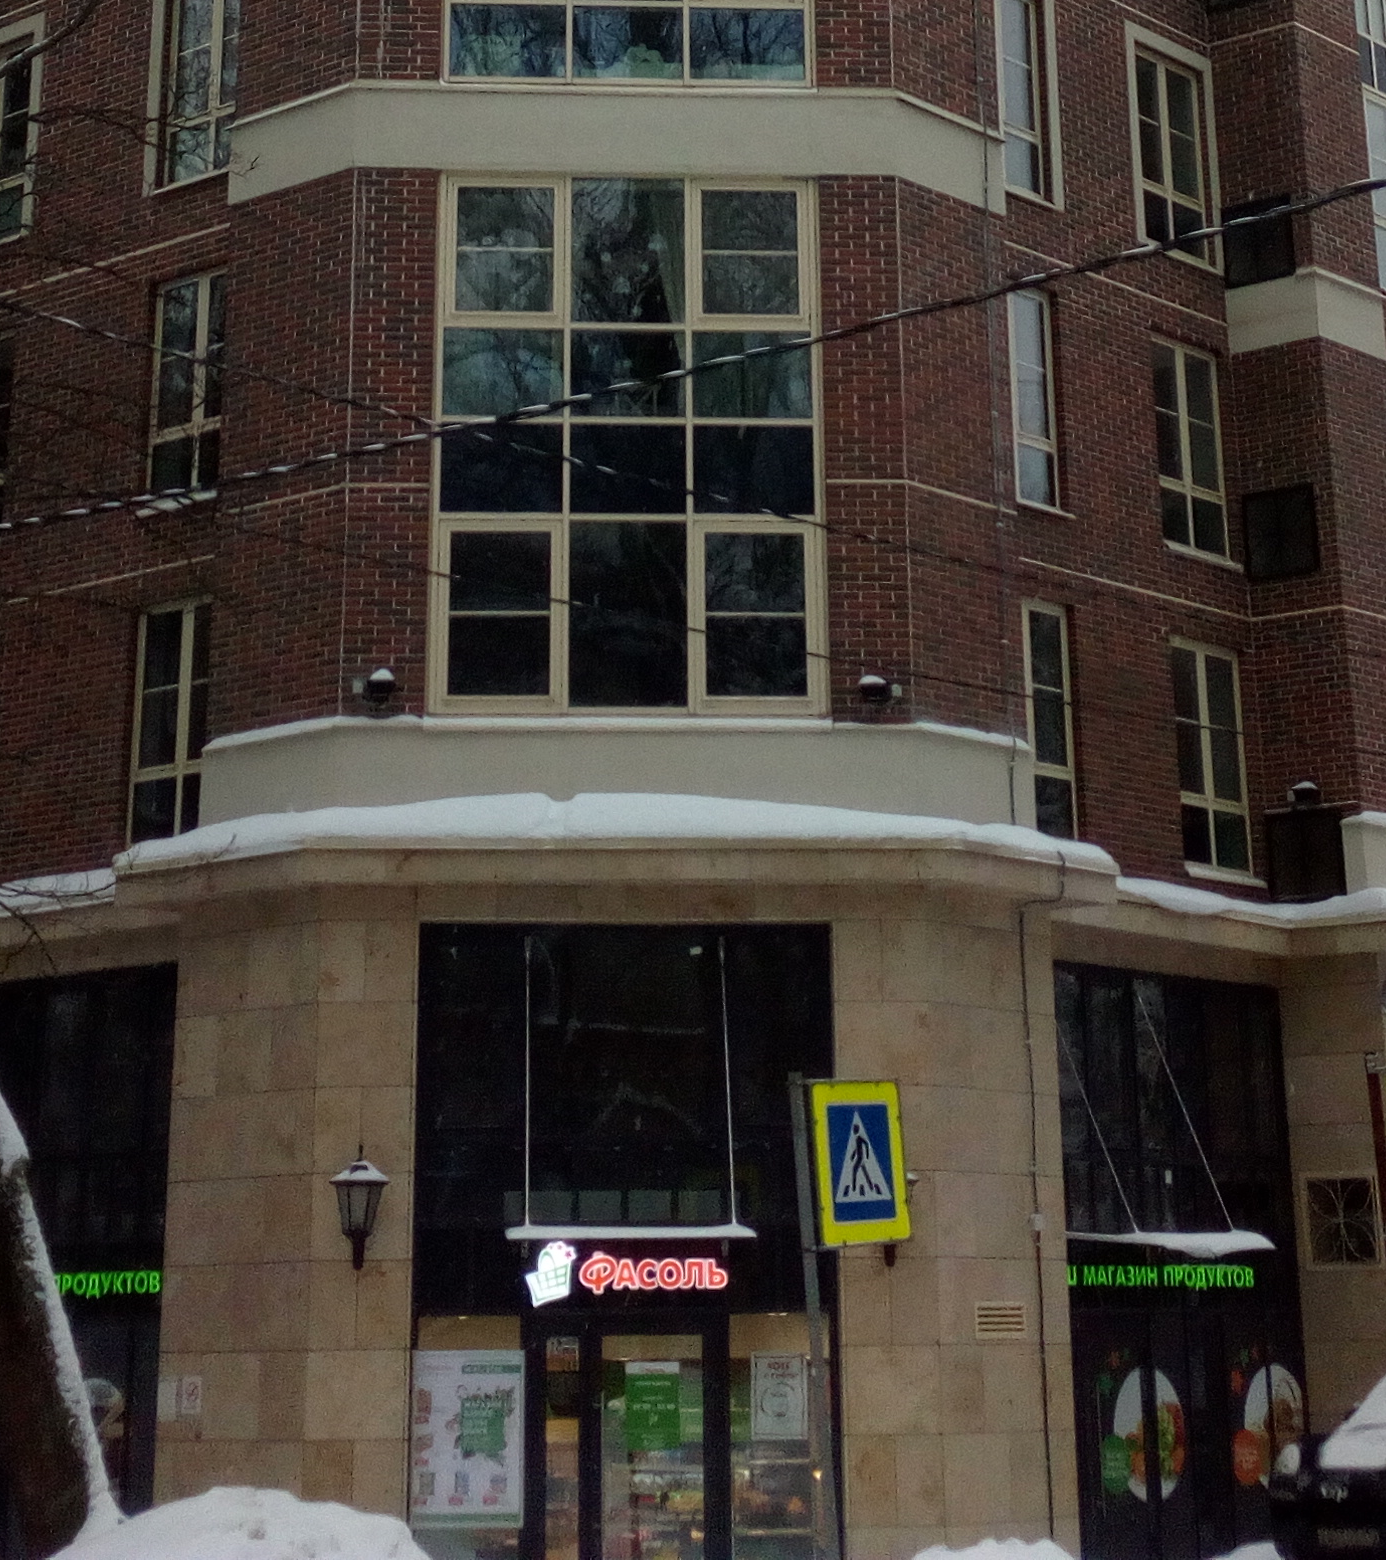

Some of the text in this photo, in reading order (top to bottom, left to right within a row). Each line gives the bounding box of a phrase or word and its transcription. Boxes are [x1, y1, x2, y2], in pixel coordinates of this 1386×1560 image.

[579, 1251, 728, 1294] ФАСОЛЬ
[1083, 1265, 1158, 1287] МАГАЗИН
[1163, 1265, 1255, 1291] ПРОДУКТОВ
